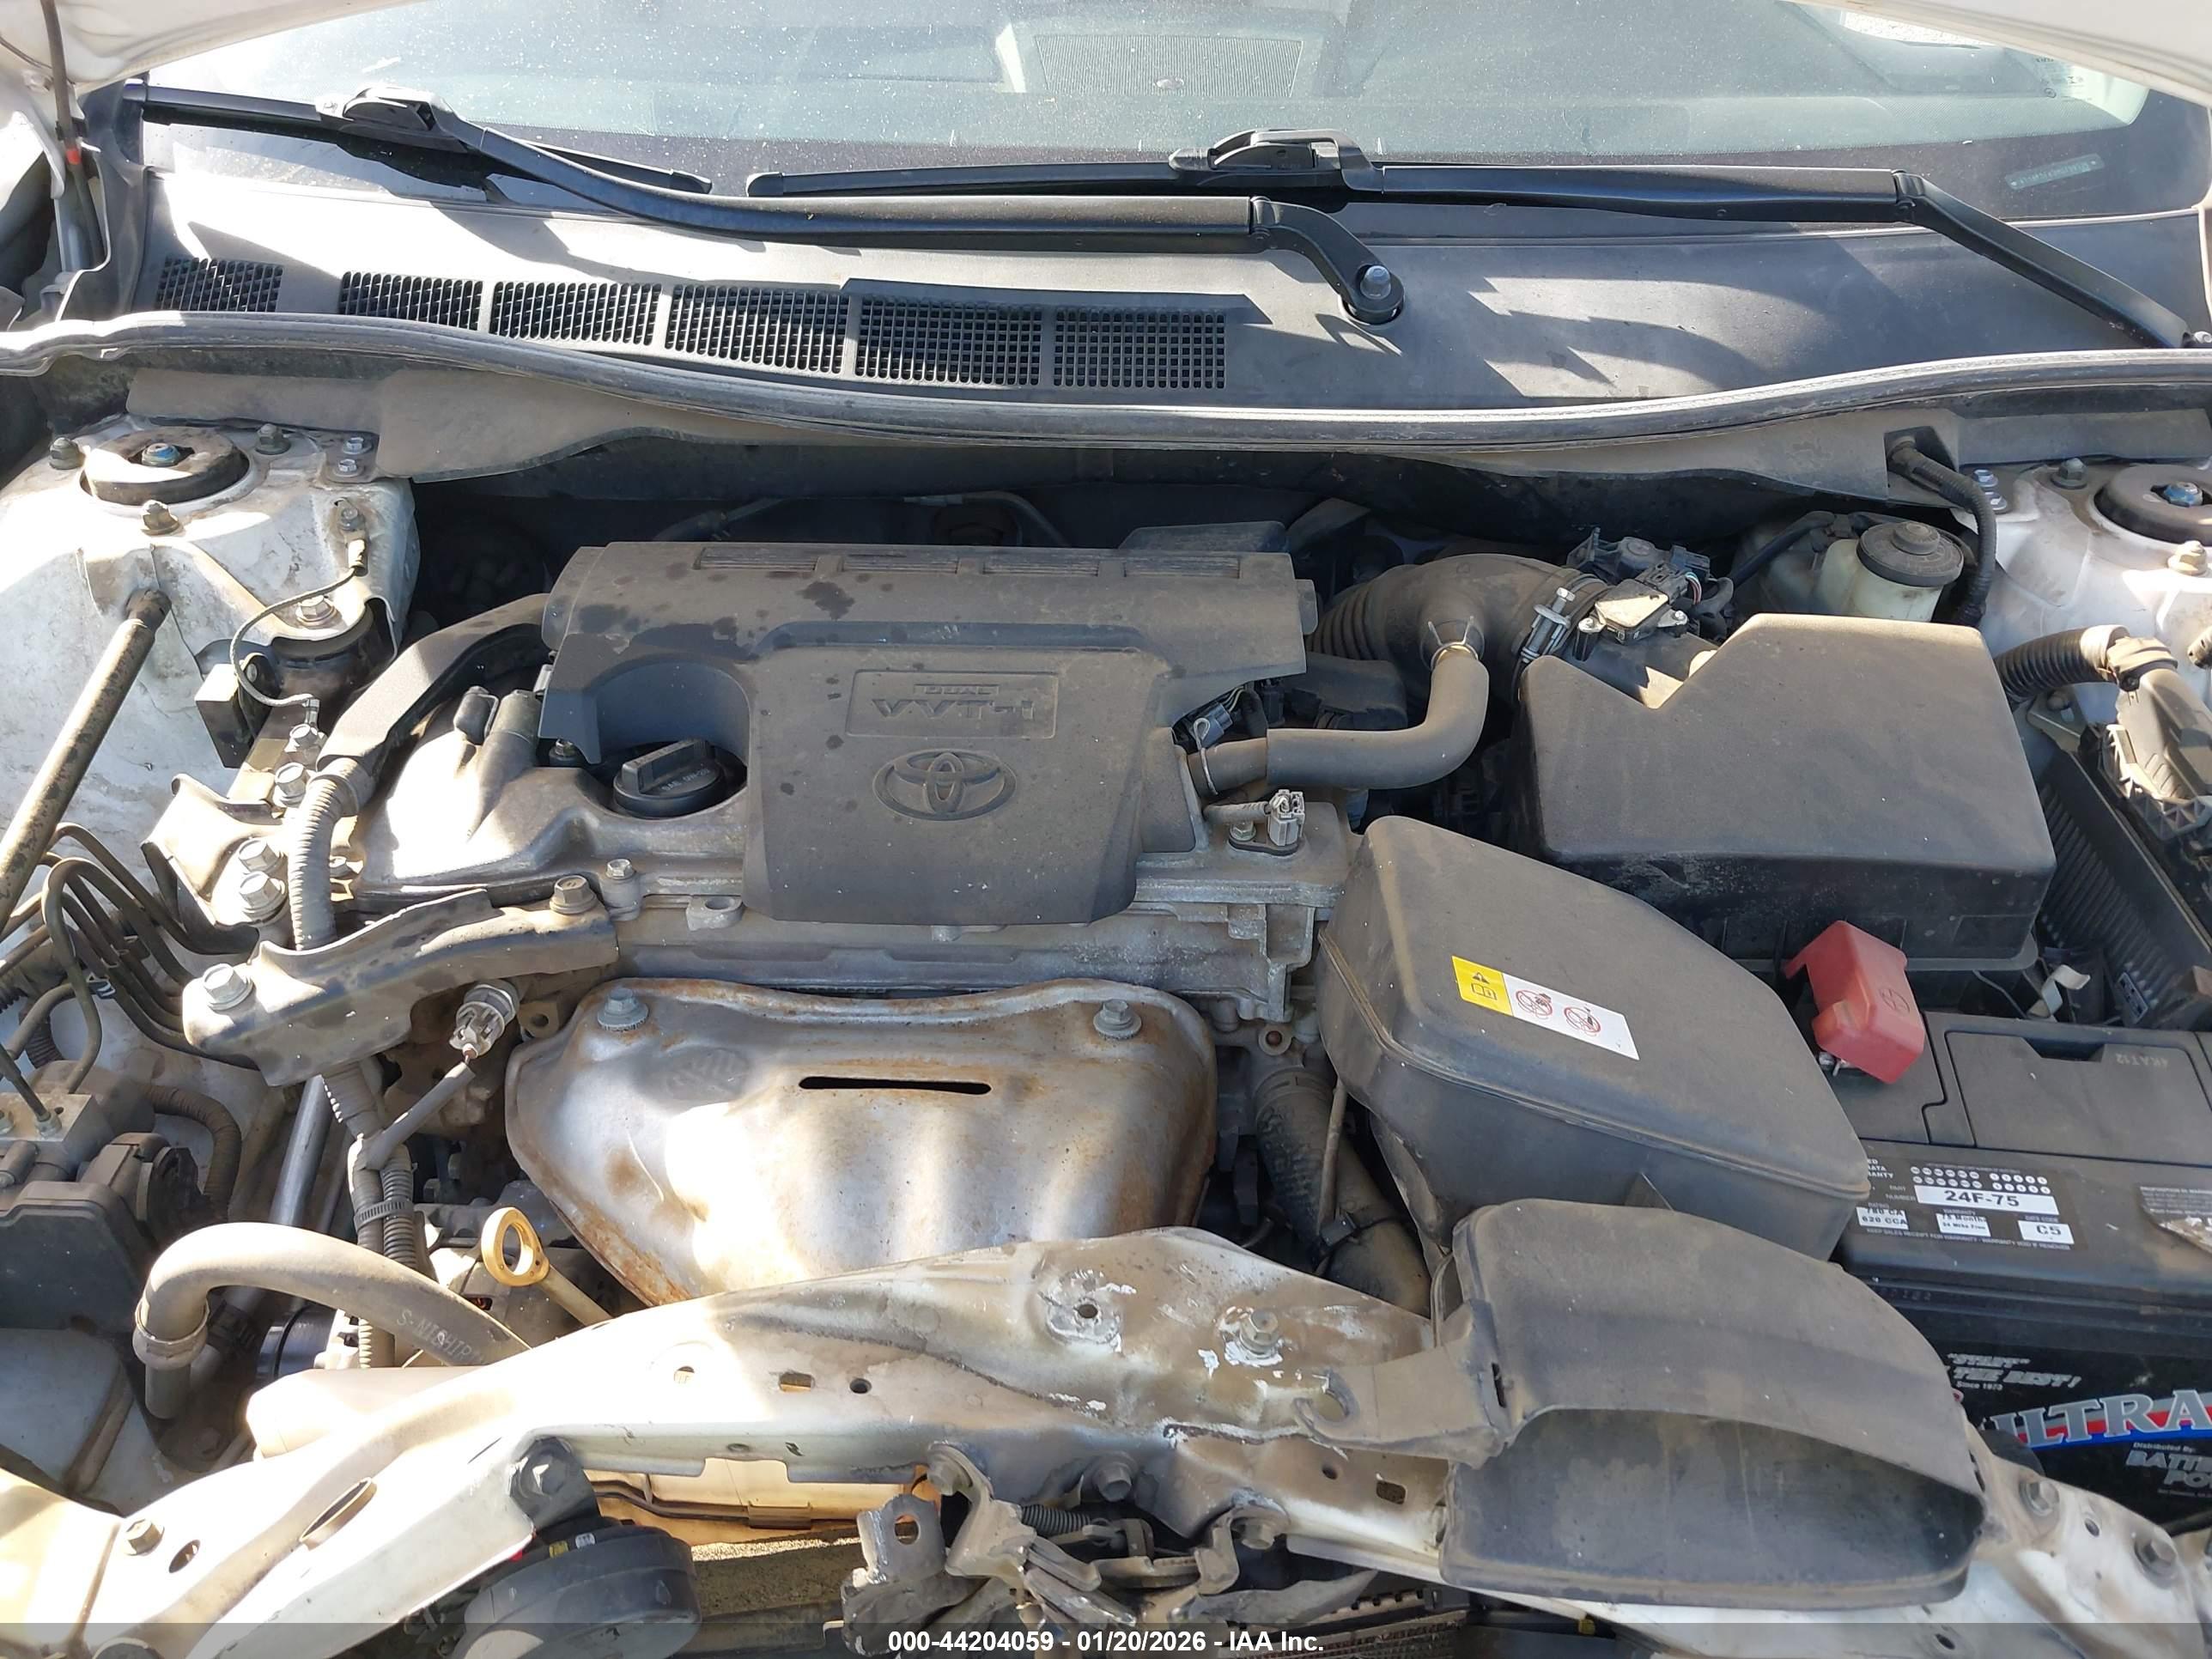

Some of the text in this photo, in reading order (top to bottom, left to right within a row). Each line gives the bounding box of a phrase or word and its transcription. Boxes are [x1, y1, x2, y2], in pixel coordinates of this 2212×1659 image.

[924, 684, 994, 695] DUAL
[1943, 1189, 2021, 1207] 24F-75
[2036, 1224, 2062, 1237] C5
[2125, 1450, 2212, 1474] BATTE
[2164, 1469, 2212, 1489] PO
